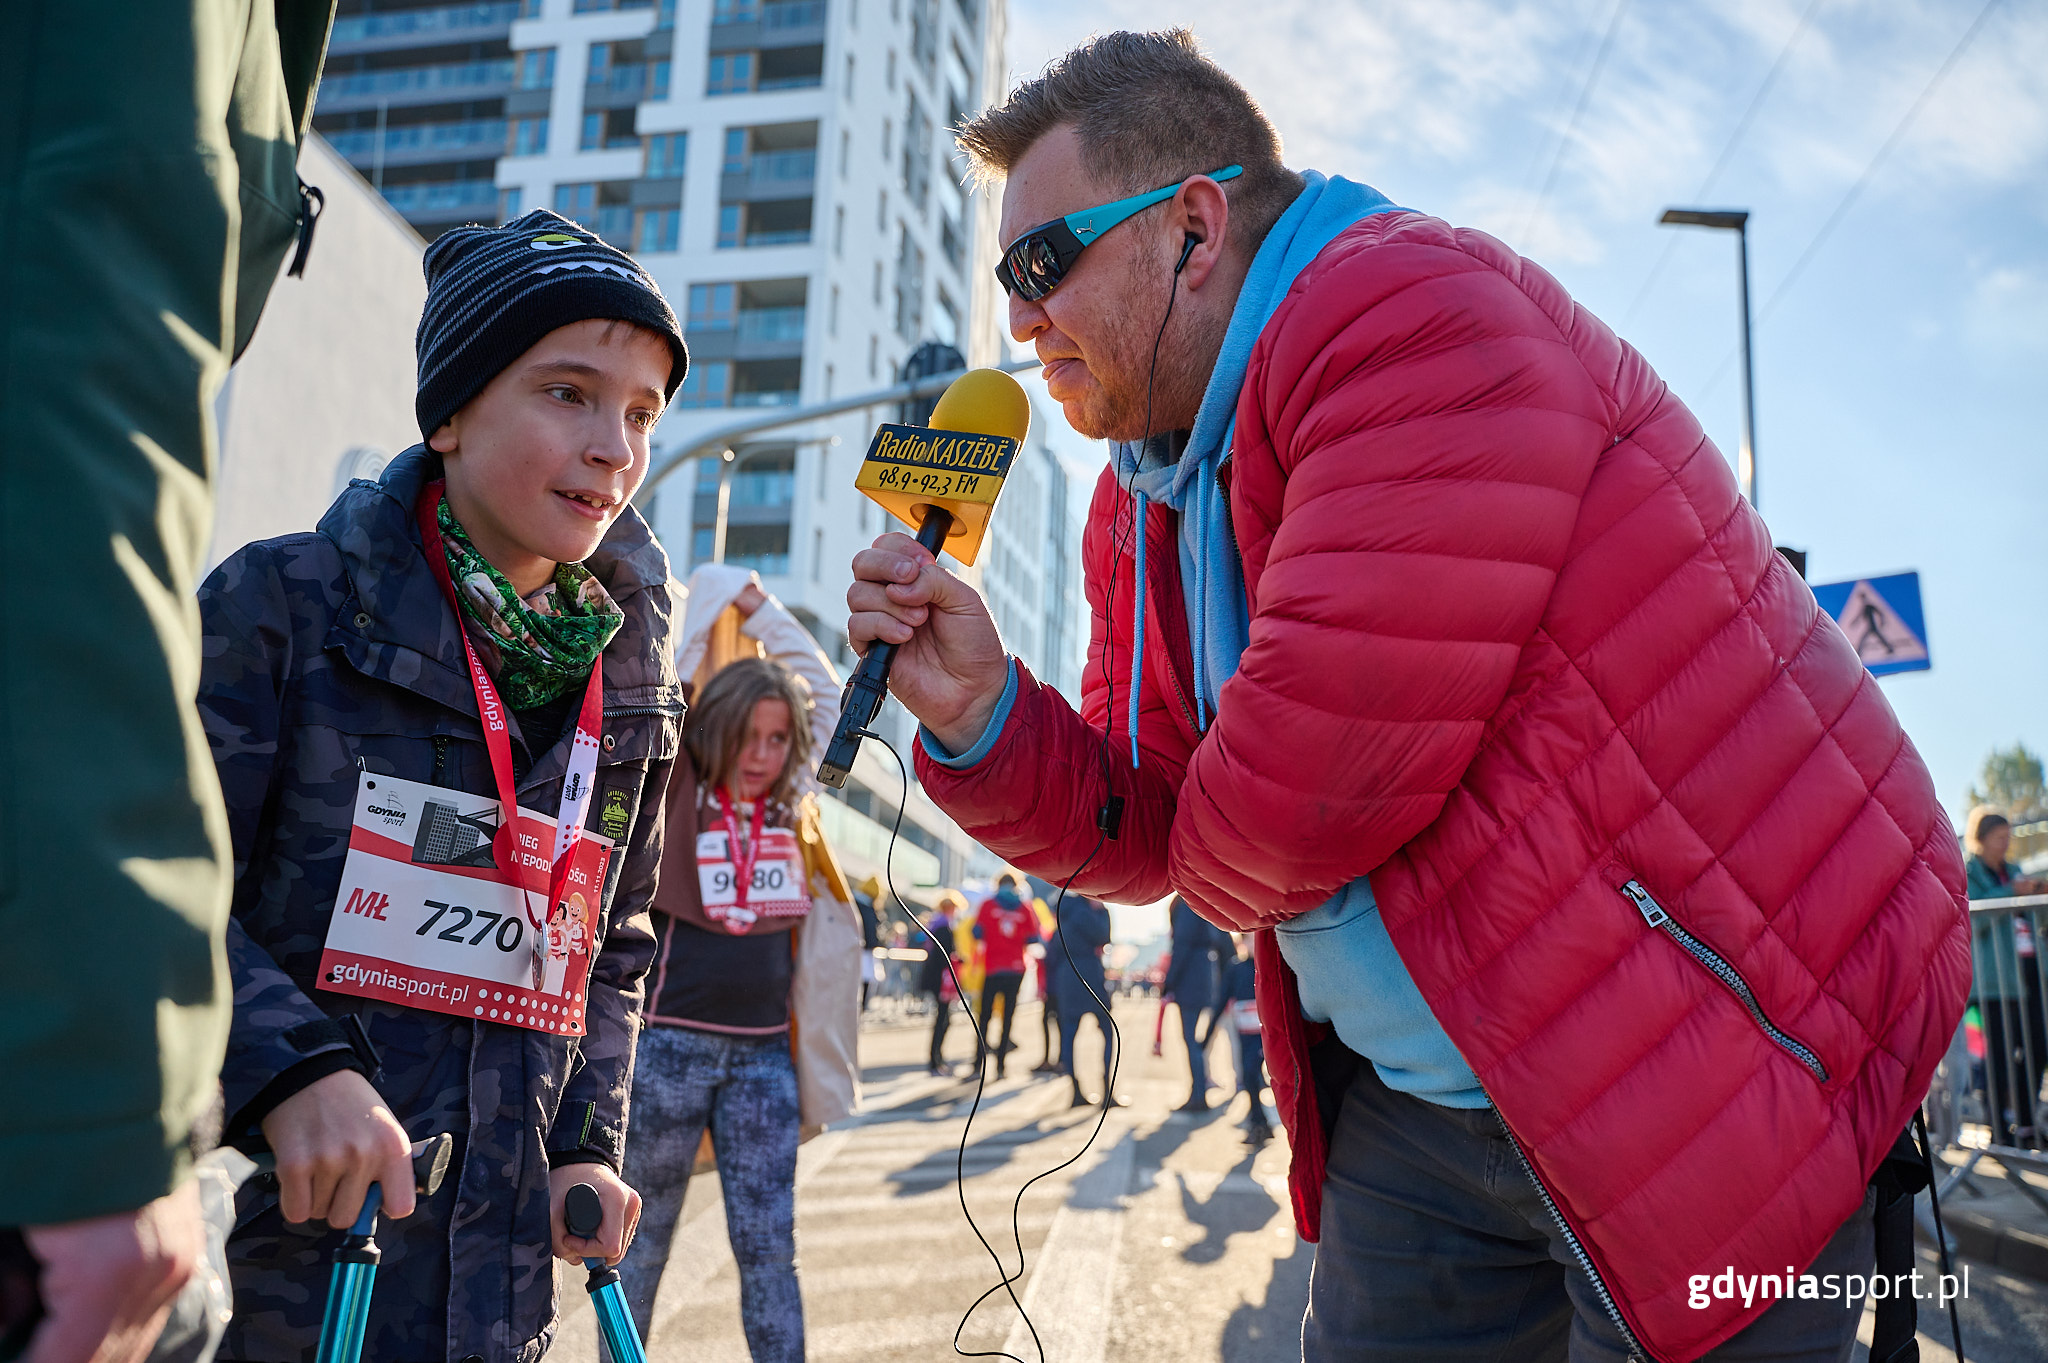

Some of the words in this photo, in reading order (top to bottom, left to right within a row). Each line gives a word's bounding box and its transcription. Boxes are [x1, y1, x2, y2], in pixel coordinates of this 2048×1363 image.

[875, 431, 927, 460] Radio
[925, 437, 1009, 471] KASZËBË
[955, 474, 980, 494] FM
[367, 805, 406, 819] GDYNIA
[383, 817, 405, 826] sport
[343, 887, 389, 921] MŁ
[416, 899, 524, 952] 7270
[332, 963, 470, 1005] gdyniasport.pl
